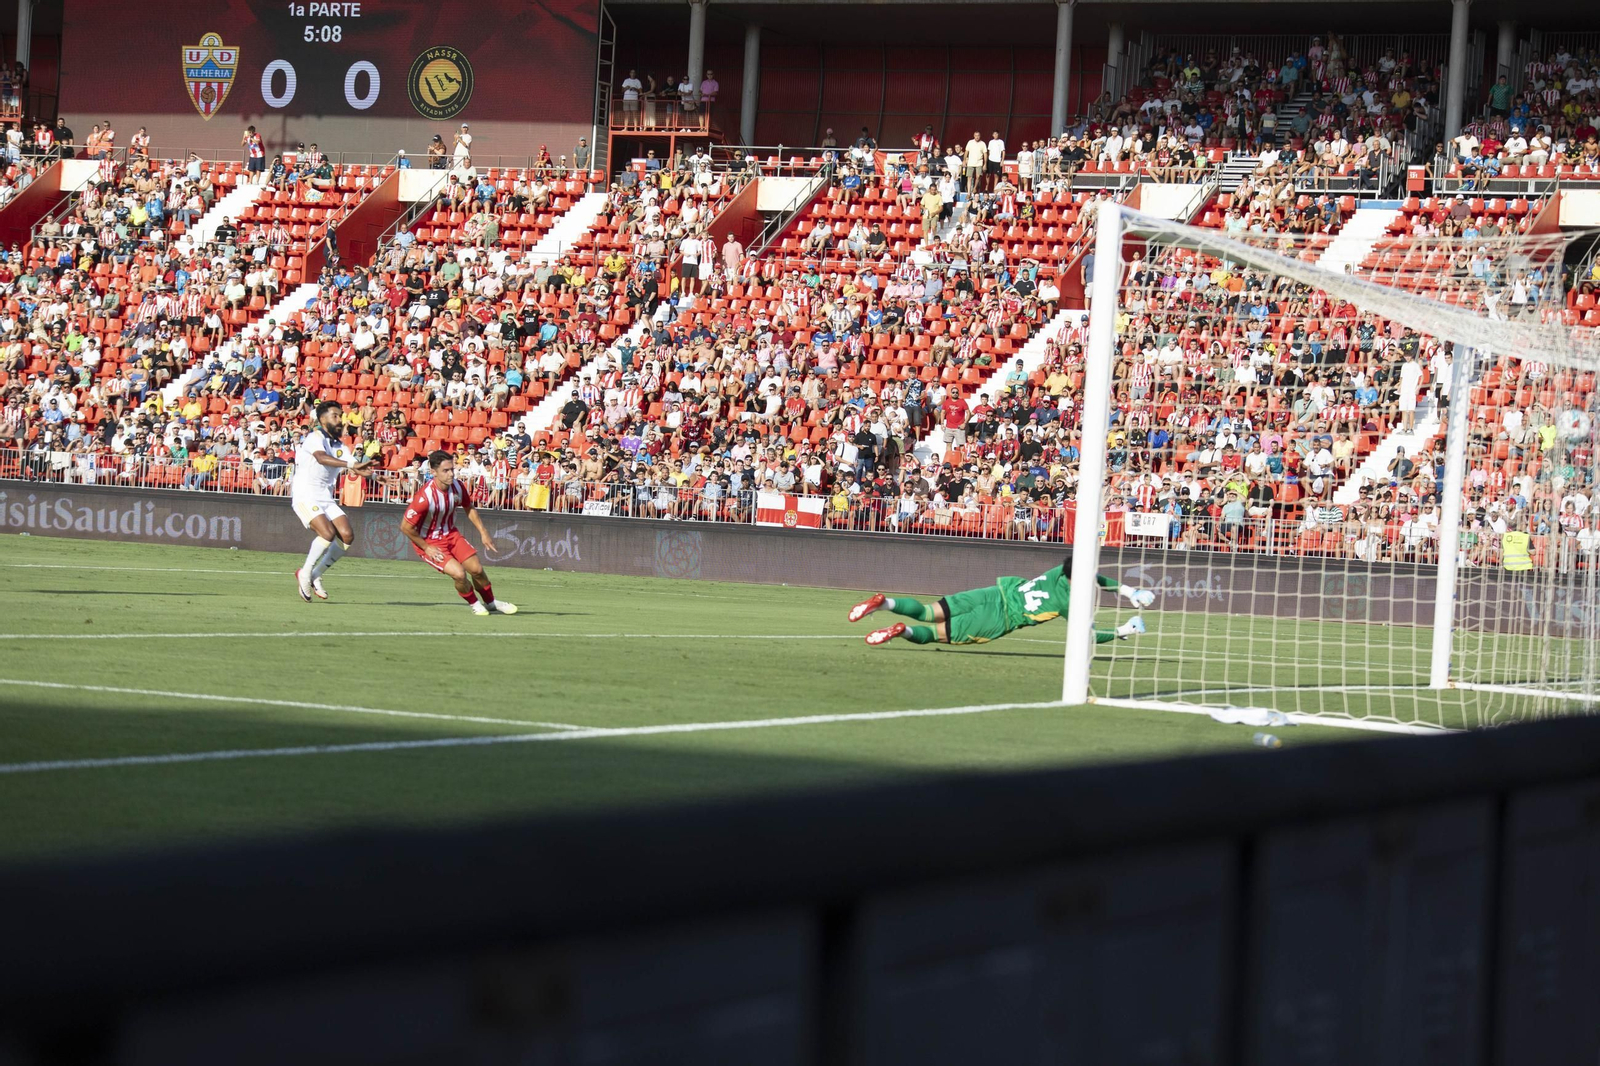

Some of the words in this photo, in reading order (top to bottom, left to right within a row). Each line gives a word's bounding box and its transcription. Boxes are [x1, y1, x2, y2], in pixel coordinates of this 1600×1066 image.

[288, 2, 305, 17] 1a
[309, 2, 361, 17] PARTE
[303, 25, 342, 42] 5:08
[188, 51, 201, 62] U
[219, 51, 232, 62] D
[426, 49, 458, 61] NASSR
[188, 69, 231, 78] ALMERIA
[261, 59, 297, 108] 0
[344, 60, 381, 110] 0
[419, 103, 443, 116] RIYADH
[484, 524, 582, 562] Saudi
